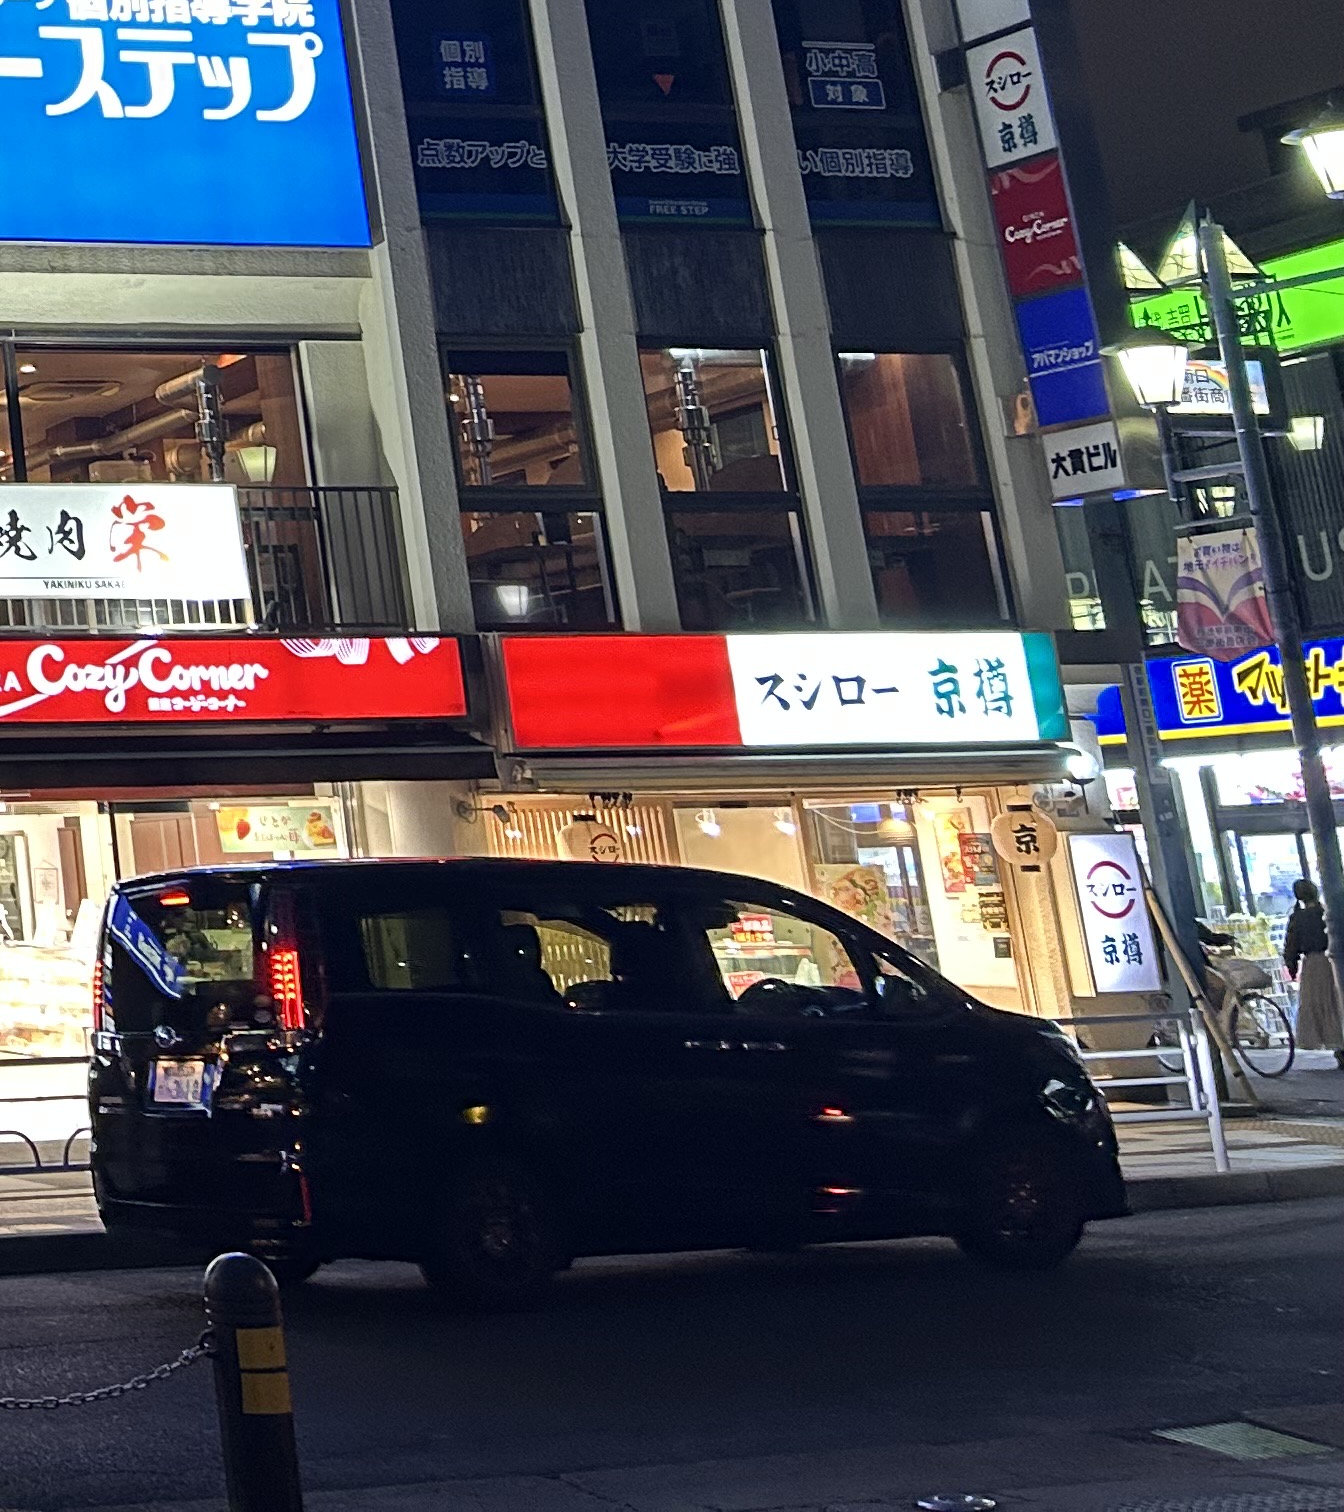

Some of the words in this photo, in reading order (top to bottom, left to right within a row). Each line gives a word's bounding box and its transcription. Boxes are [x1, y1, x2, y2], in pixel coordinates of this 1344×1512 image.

[440, 40, 485, 64] 個別
[443, 66, 489, 90] 指導
[825, 82, 869, 104] 対象
[985, 71, 1033, 96] スシロー
[998, 112, 1039, 154] 京樽
[417, 139, 548, 169] 点数アップと
[607, 143, 740, 175] 大学受験に強
[648, 203, 678, 215] FREE
[680, 203, 710, 216] STEP
[1031, 339, 1095, 369] アパマンショップ
[1051, 441, 1118, 480] 大貫ビル
[43, 580, 92, 590] YAKINIKU
[26, 644, 140, 713] Cozy
[138, 647, 269, 694] Corner
[754, 672, 900, 711] スシロー
[927, 657, 1015, 719] 京樽
[1178, 666, 1217, 716] 薬
[1012, 823, 1040, 856] 京
[1086, 882, 1138, 898] スシロー
[1101, 931, 1144, 967] 京樽
